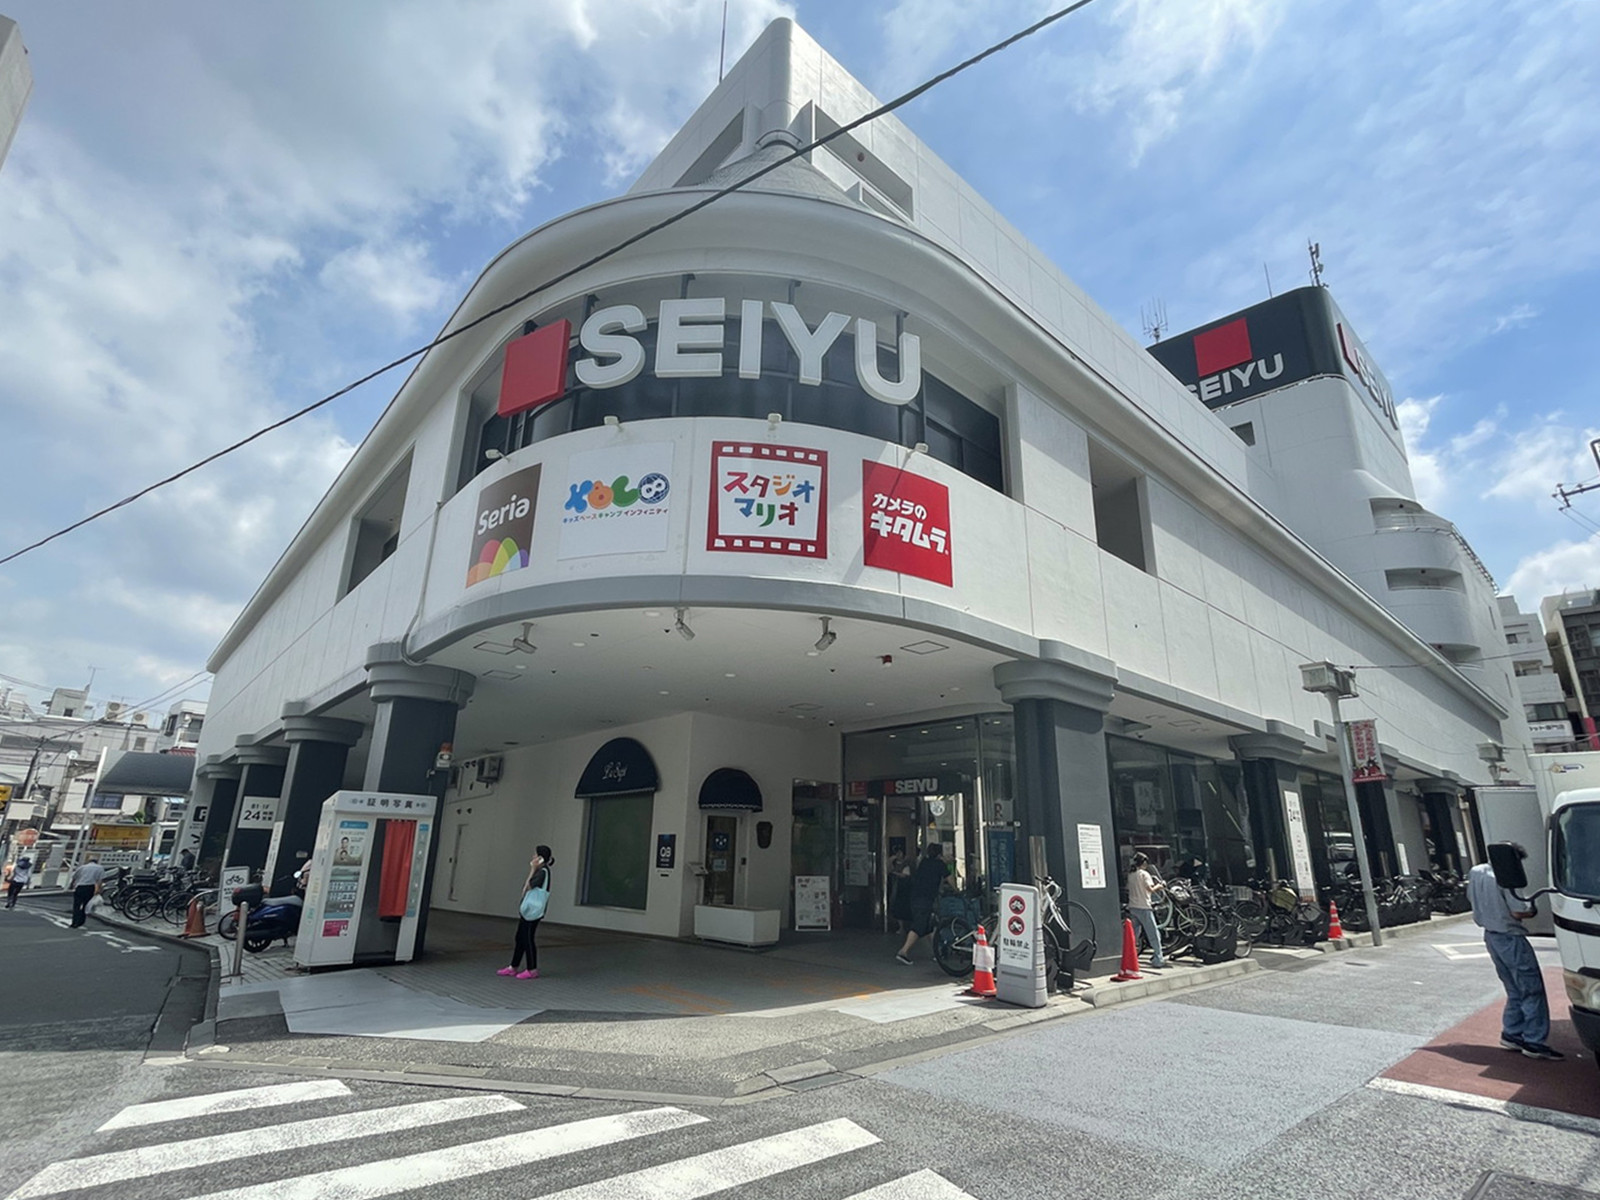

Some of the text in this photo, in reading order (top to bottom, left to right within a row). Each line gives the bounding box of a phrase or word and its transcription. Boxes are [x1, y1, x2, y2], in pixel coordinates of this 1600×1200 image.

[575, 297, 922, 405] SEIYU
[723, 470, 816, 504] スタジオ
[476, 494, 531, 538] Seria
[734, 497, 800, 528] マリオ
[872, 493, 928, 520] カメラの
[870, 510, 947, 553] キタムラ
[895, 778, 938, 794] SEIYU
[367, 798, 413, 809] 証明写真
